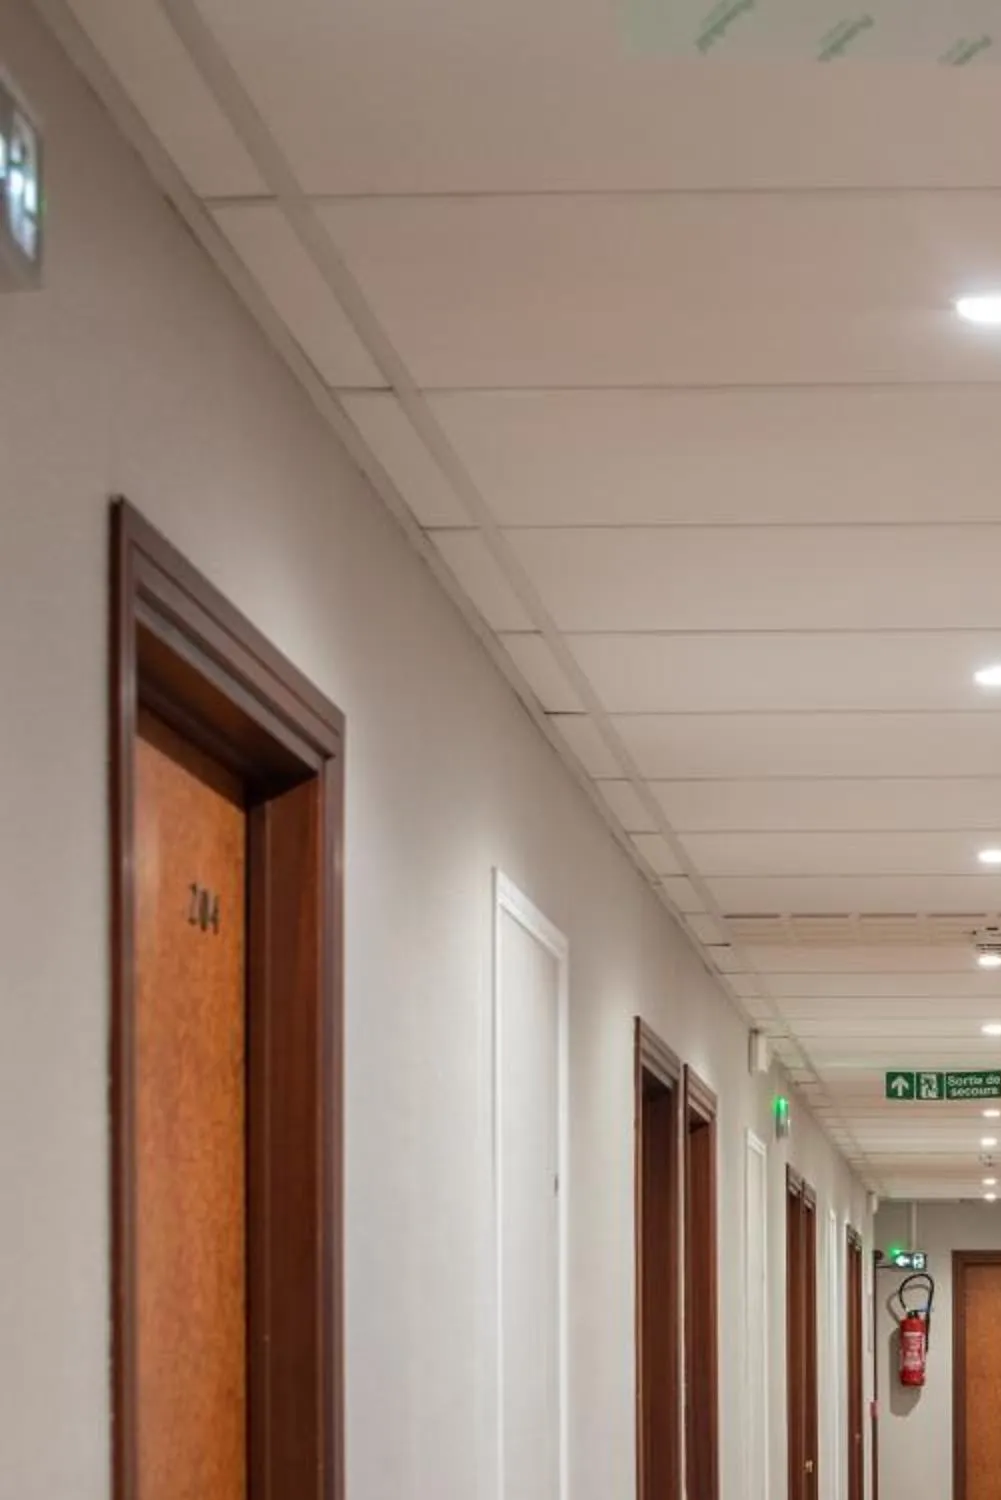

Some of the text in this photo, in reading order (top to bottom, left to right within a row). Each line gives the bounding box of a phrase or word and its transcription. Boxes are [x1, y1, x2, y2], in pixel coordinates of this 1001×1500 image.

[947, 1074, 1001, 1086] Sortie de
[950, 1086, 999, 1097] secours
